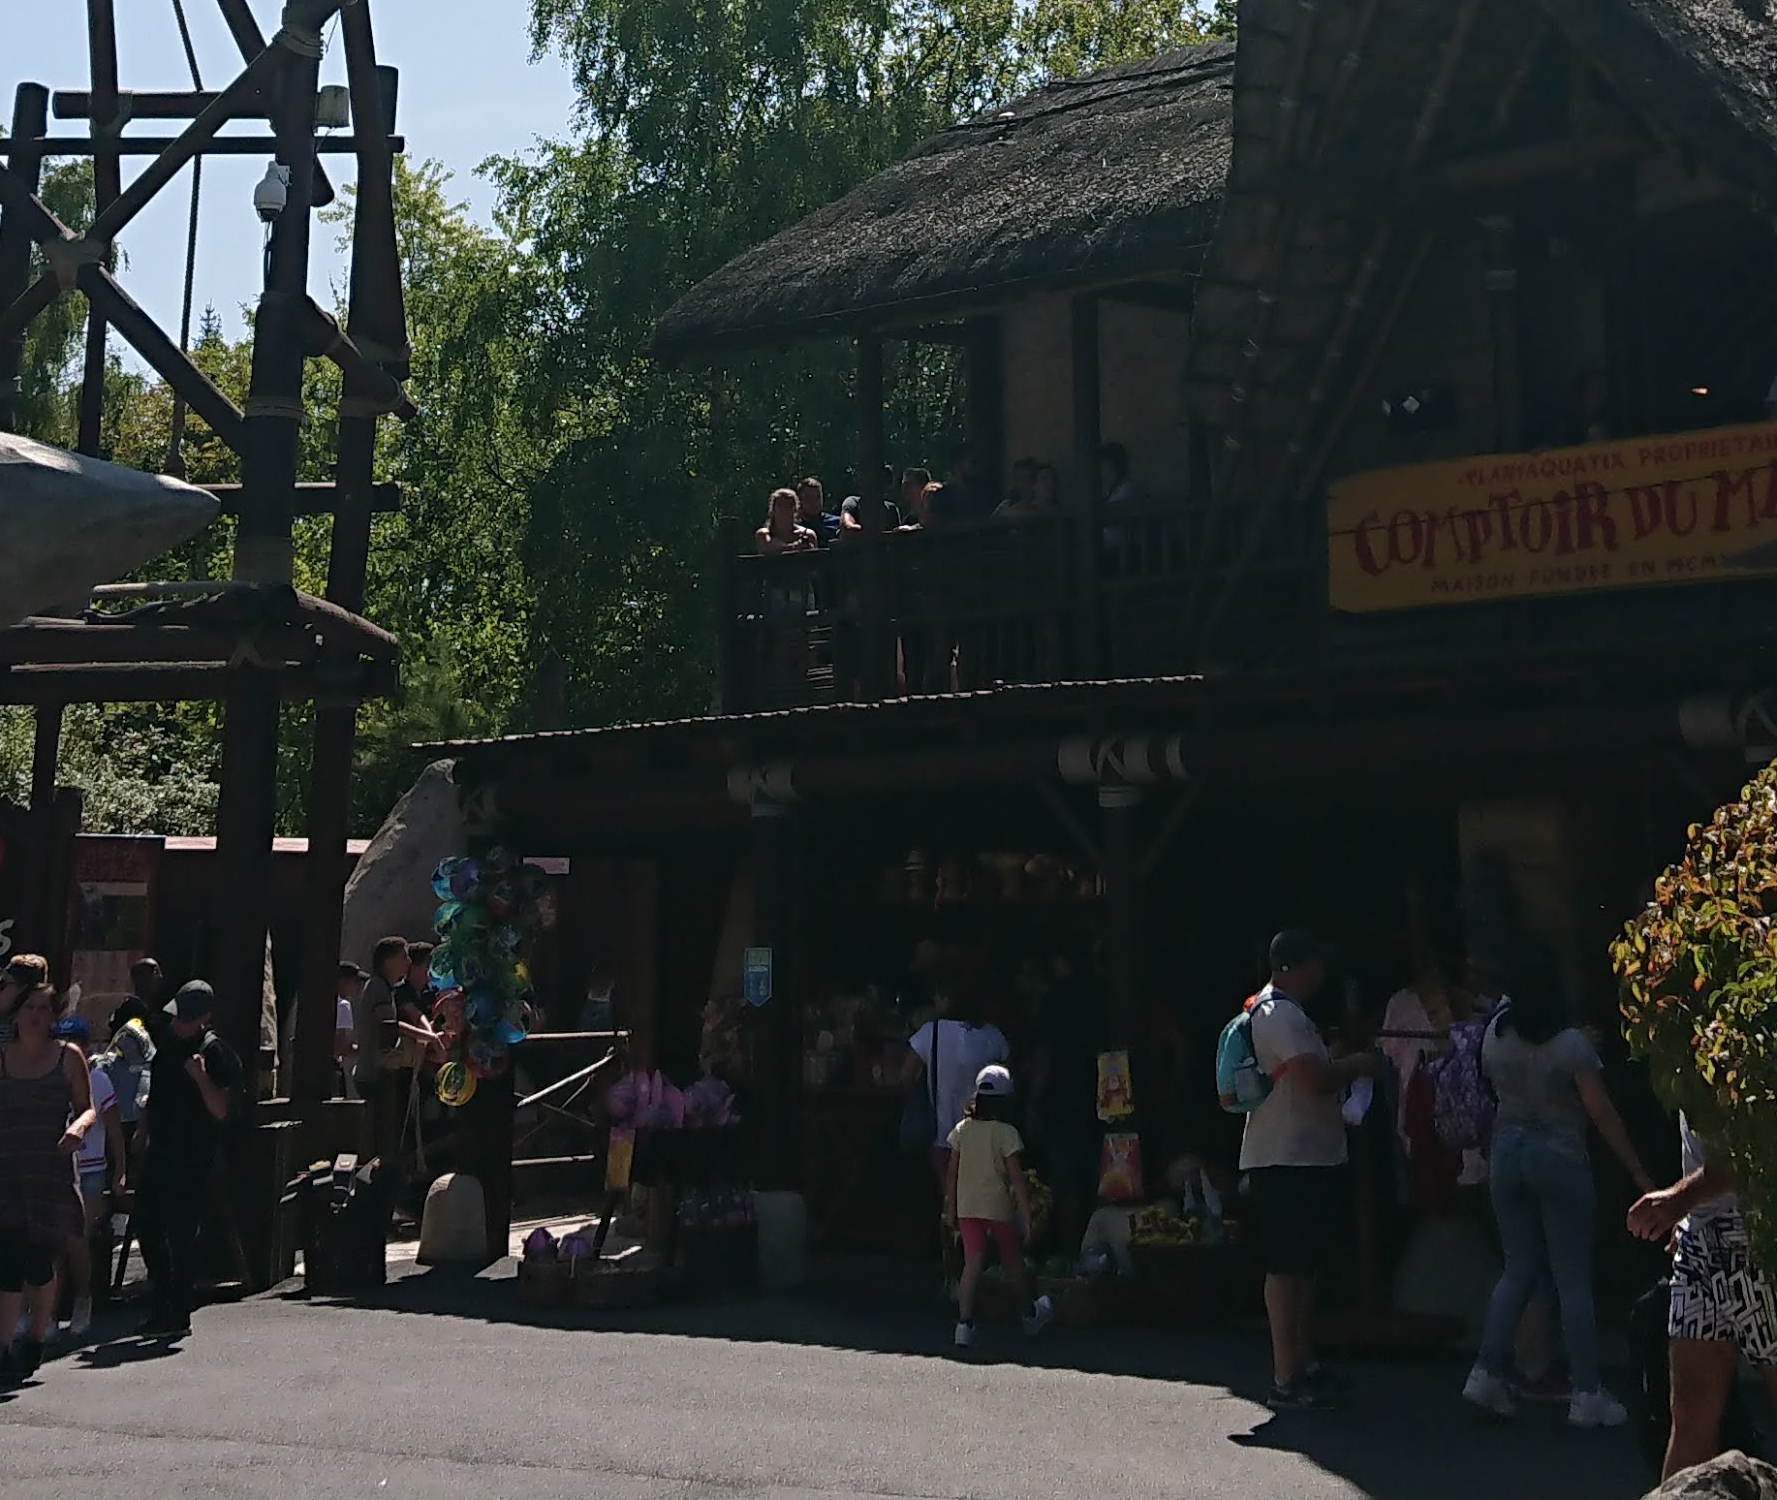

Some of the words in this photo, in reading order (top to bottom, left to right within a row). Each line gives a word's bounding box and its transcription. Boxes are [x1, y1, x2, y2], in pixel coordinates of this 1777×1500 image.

[1625, 481, 1699, 541] DU
[1430, 571, 1515, 594] MAISON
[1630, 561, 1655, 576] EN
